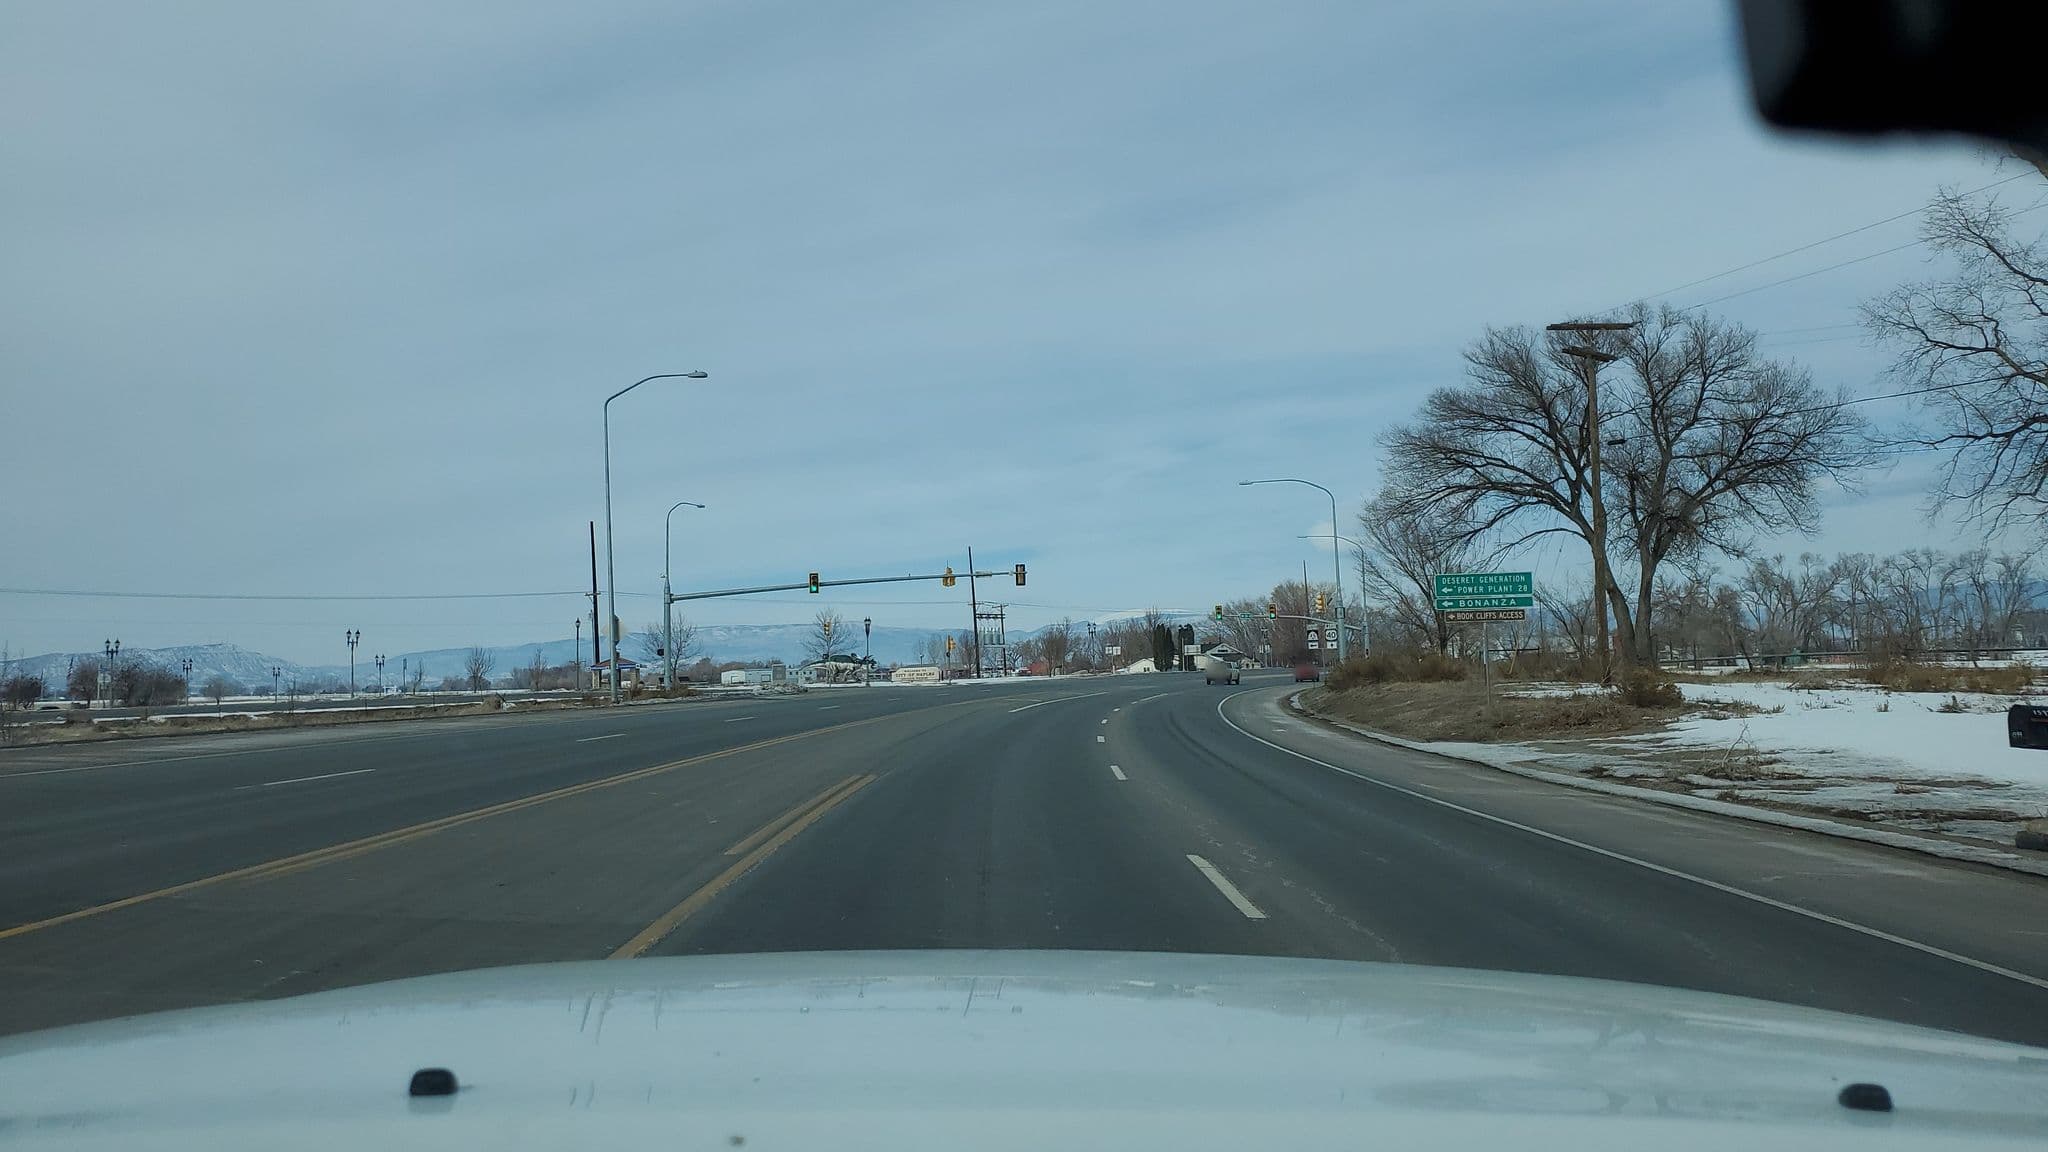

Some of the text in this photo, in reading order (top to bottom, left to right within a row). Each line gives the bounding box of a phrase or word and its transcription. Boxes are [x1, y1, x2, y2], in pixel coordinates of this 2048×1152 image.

[1442, 575, 1525, 585] DESERET GENERATION
[1459, 598, 1516, 607] BONANZA
